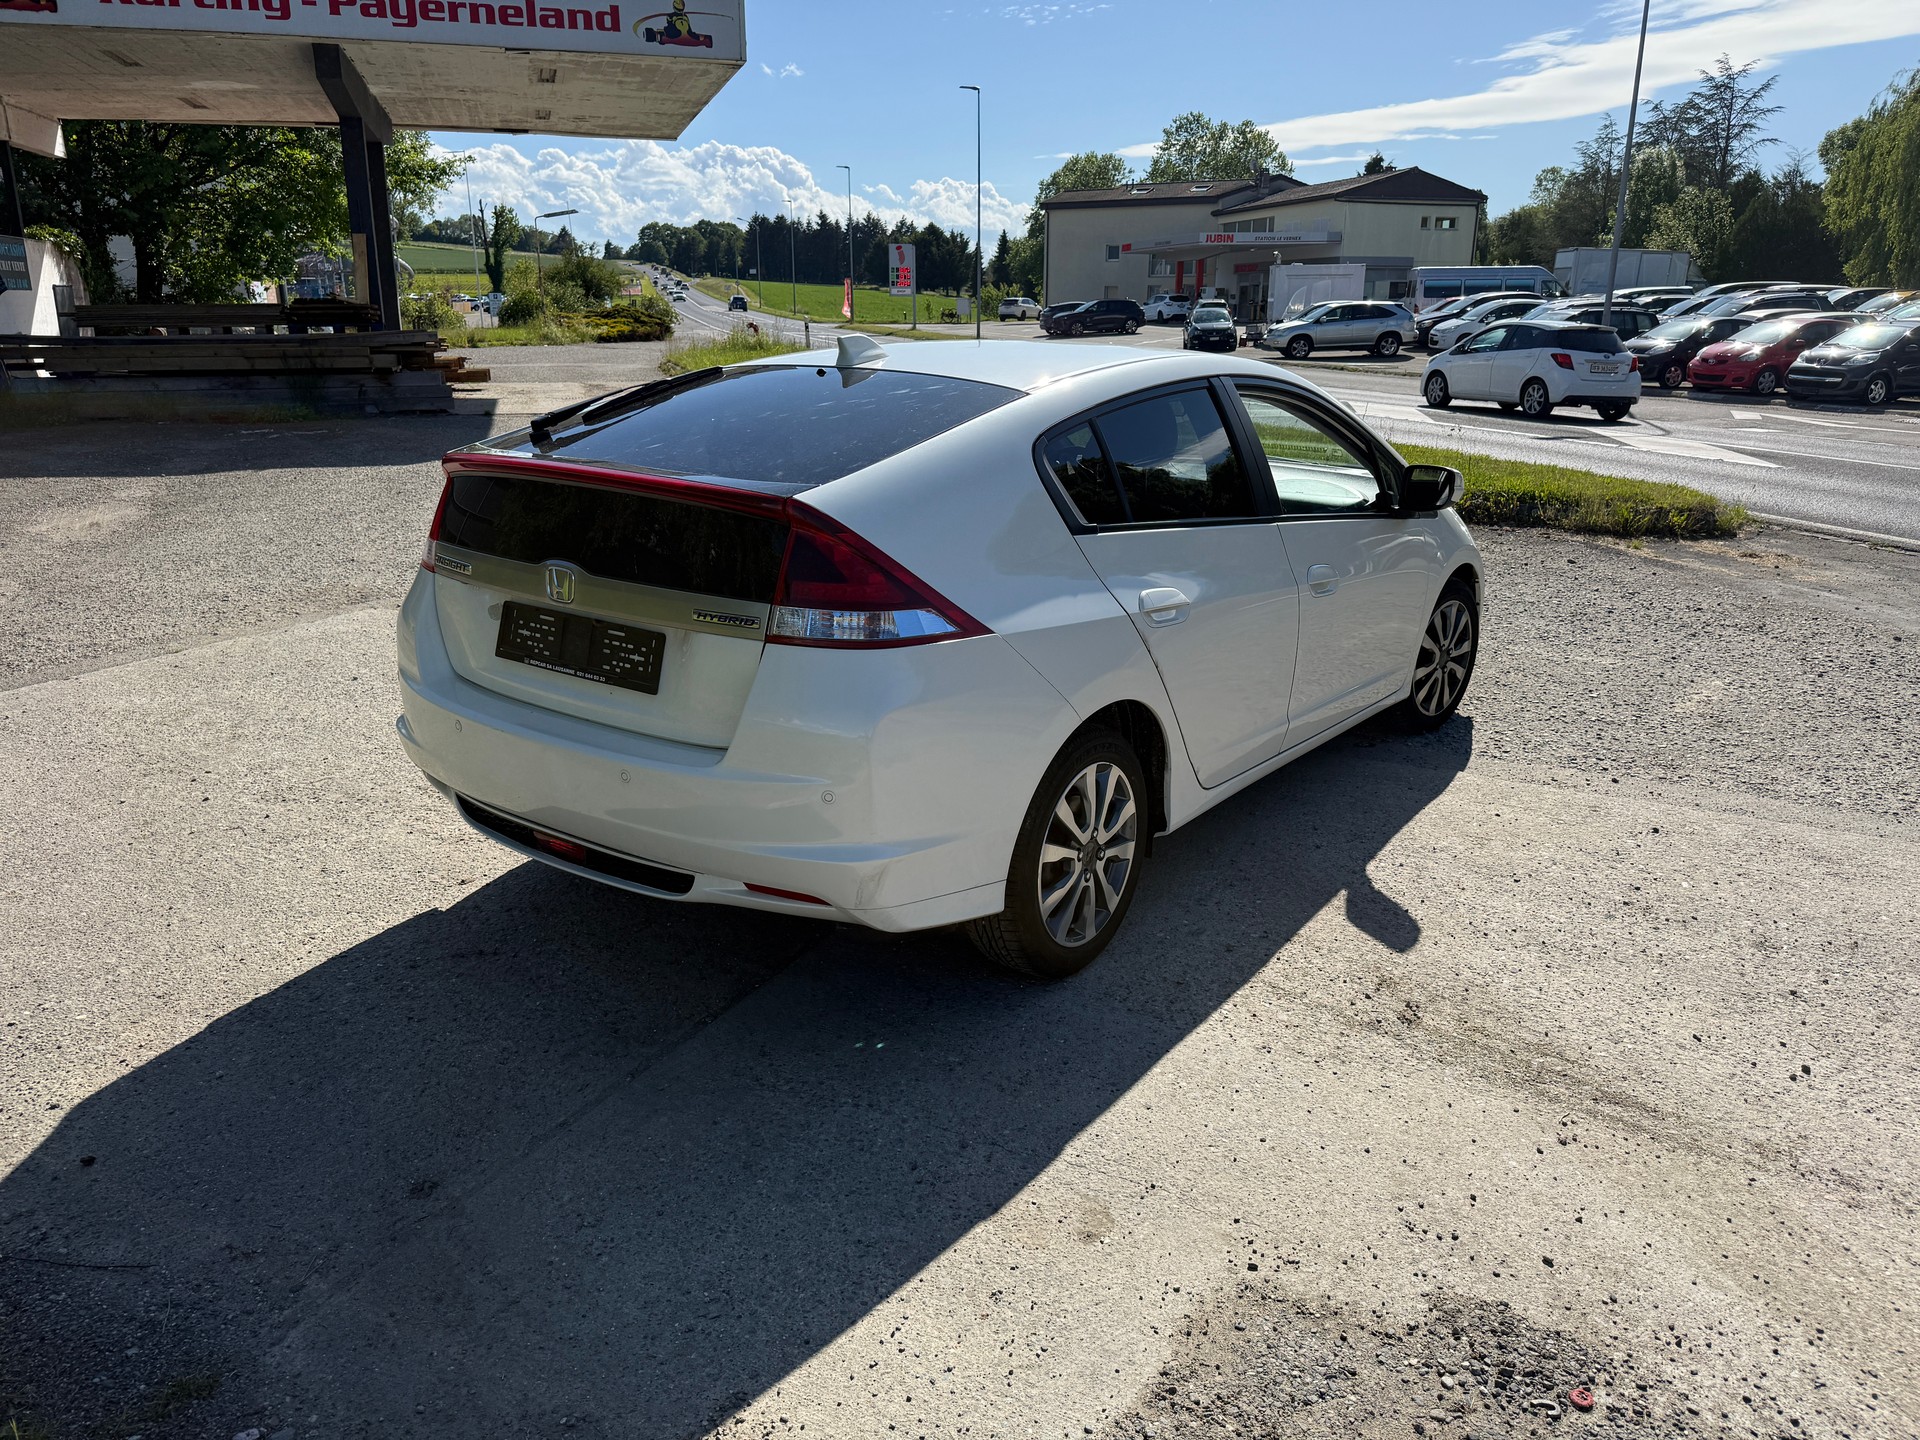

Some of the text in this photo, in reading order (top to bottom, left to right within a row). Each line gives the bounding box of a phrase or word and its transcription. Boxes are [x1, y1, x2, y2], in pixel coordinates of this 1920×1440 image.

[329, 0, 621, 33] Payerneland
[1205, 234, 1234, 243] JUBIN
[436, 556, 467, 572] INSIGHT
[696, 611, 758, 627] HYBRID
[553, 665, 575, 675] LAUSANNE
